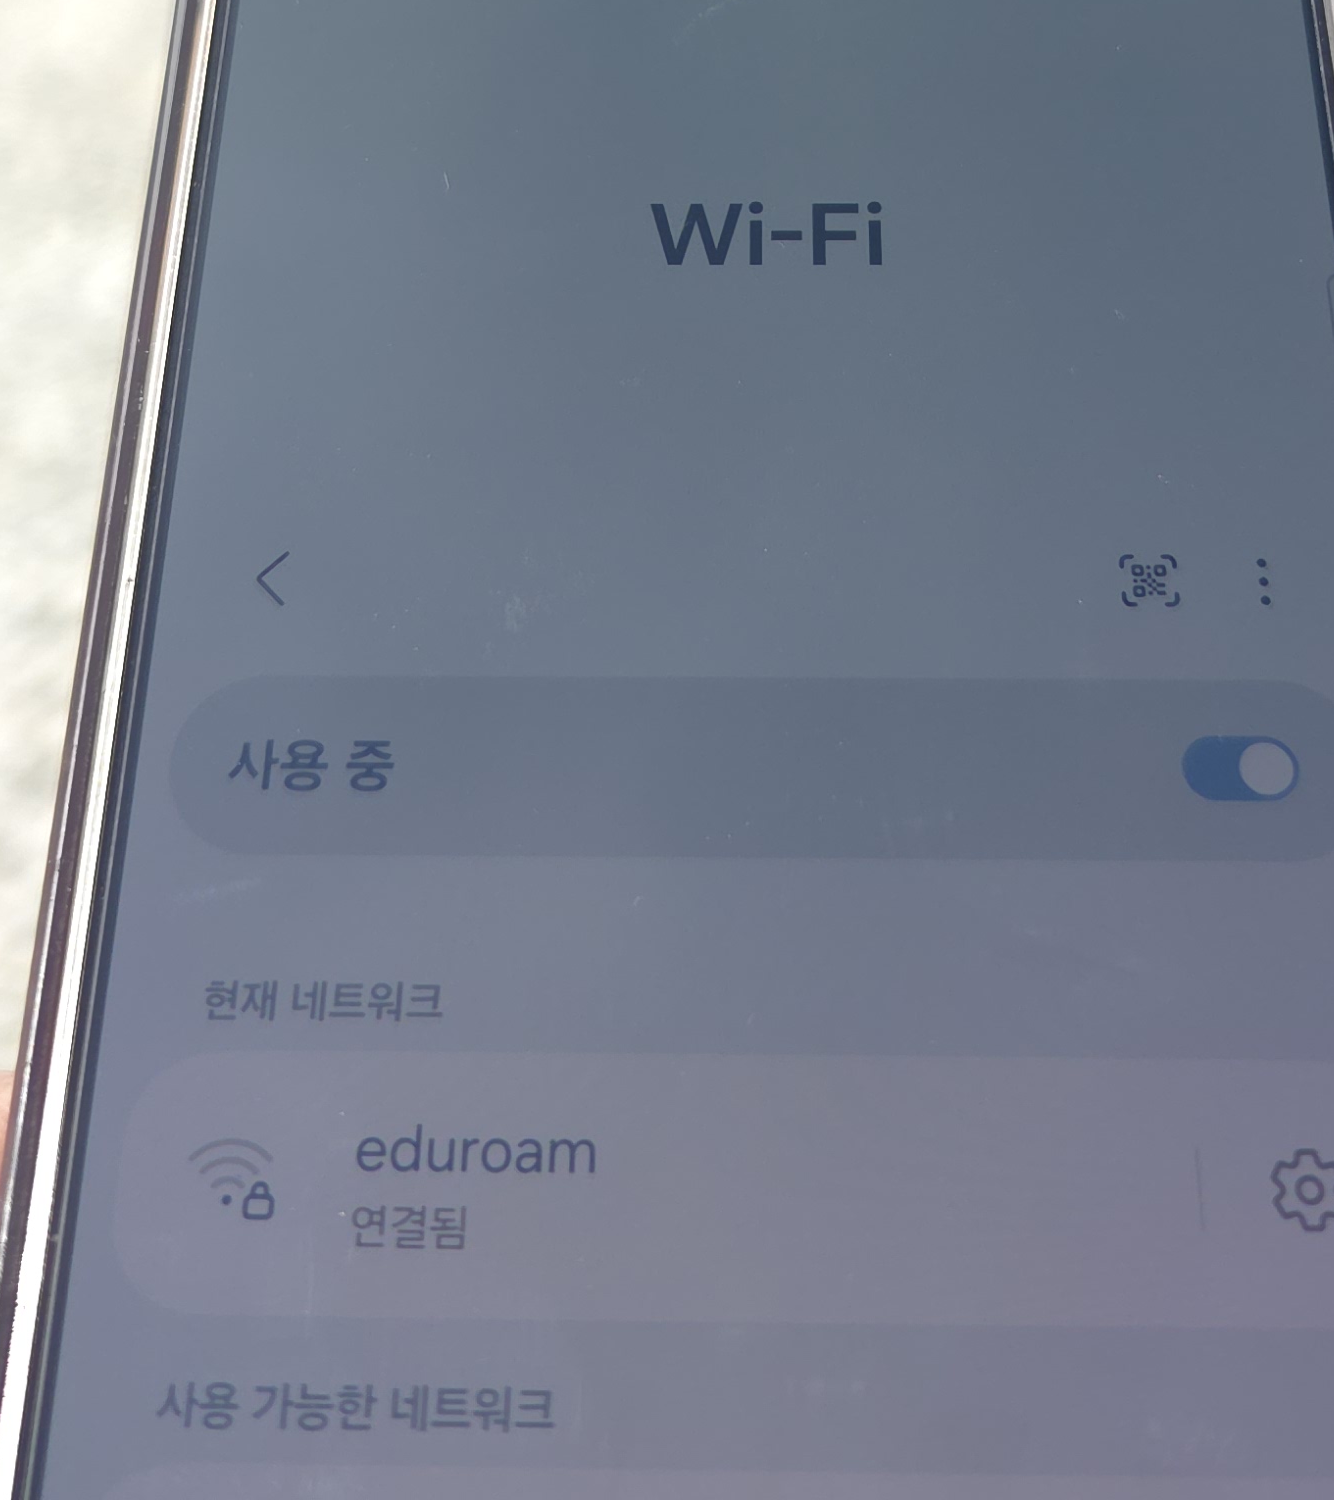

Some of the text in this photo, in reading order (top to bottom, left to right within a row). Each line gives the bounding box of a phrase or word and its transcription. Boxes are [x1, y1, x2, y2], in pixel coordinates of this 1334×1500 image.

[650, 201, 882, 265] Wi-Fi
[228, 739, 394, 791] 사용 중
[205, 980, 443, 1022] 현재 네트워크
[356, 1123, 596, 1174] eduroam
[352, 1205, 466, 1250] 연결됨
[156, 1381, 555, 1433] 사용 가능한 네트워크
